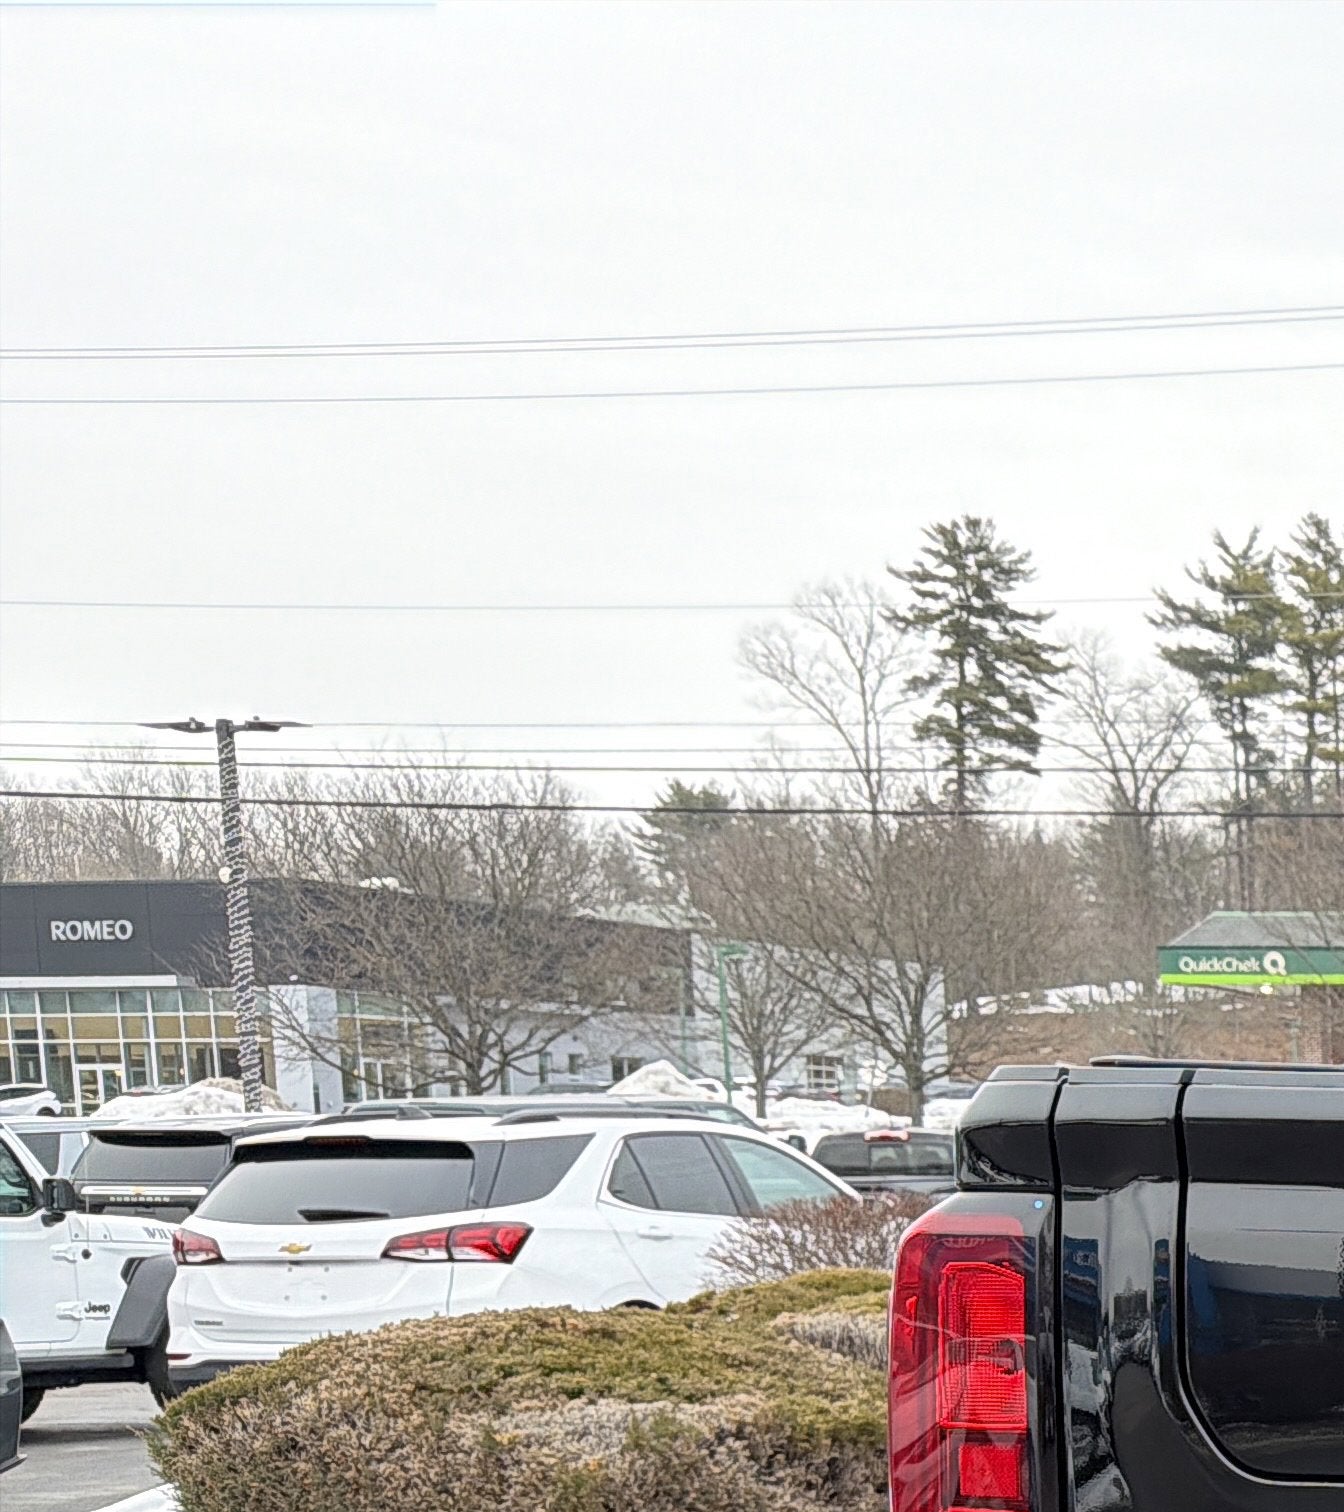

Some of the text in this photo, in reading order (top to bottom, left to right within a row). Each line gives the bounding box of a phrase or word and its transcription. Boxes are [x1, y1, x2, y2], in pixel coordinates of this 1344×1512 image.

[50, 919, 133, 941] ROMEO
[1178, 955, 1260, 973] QuickChek
[84, 1301, 111, 1314] Jeep
